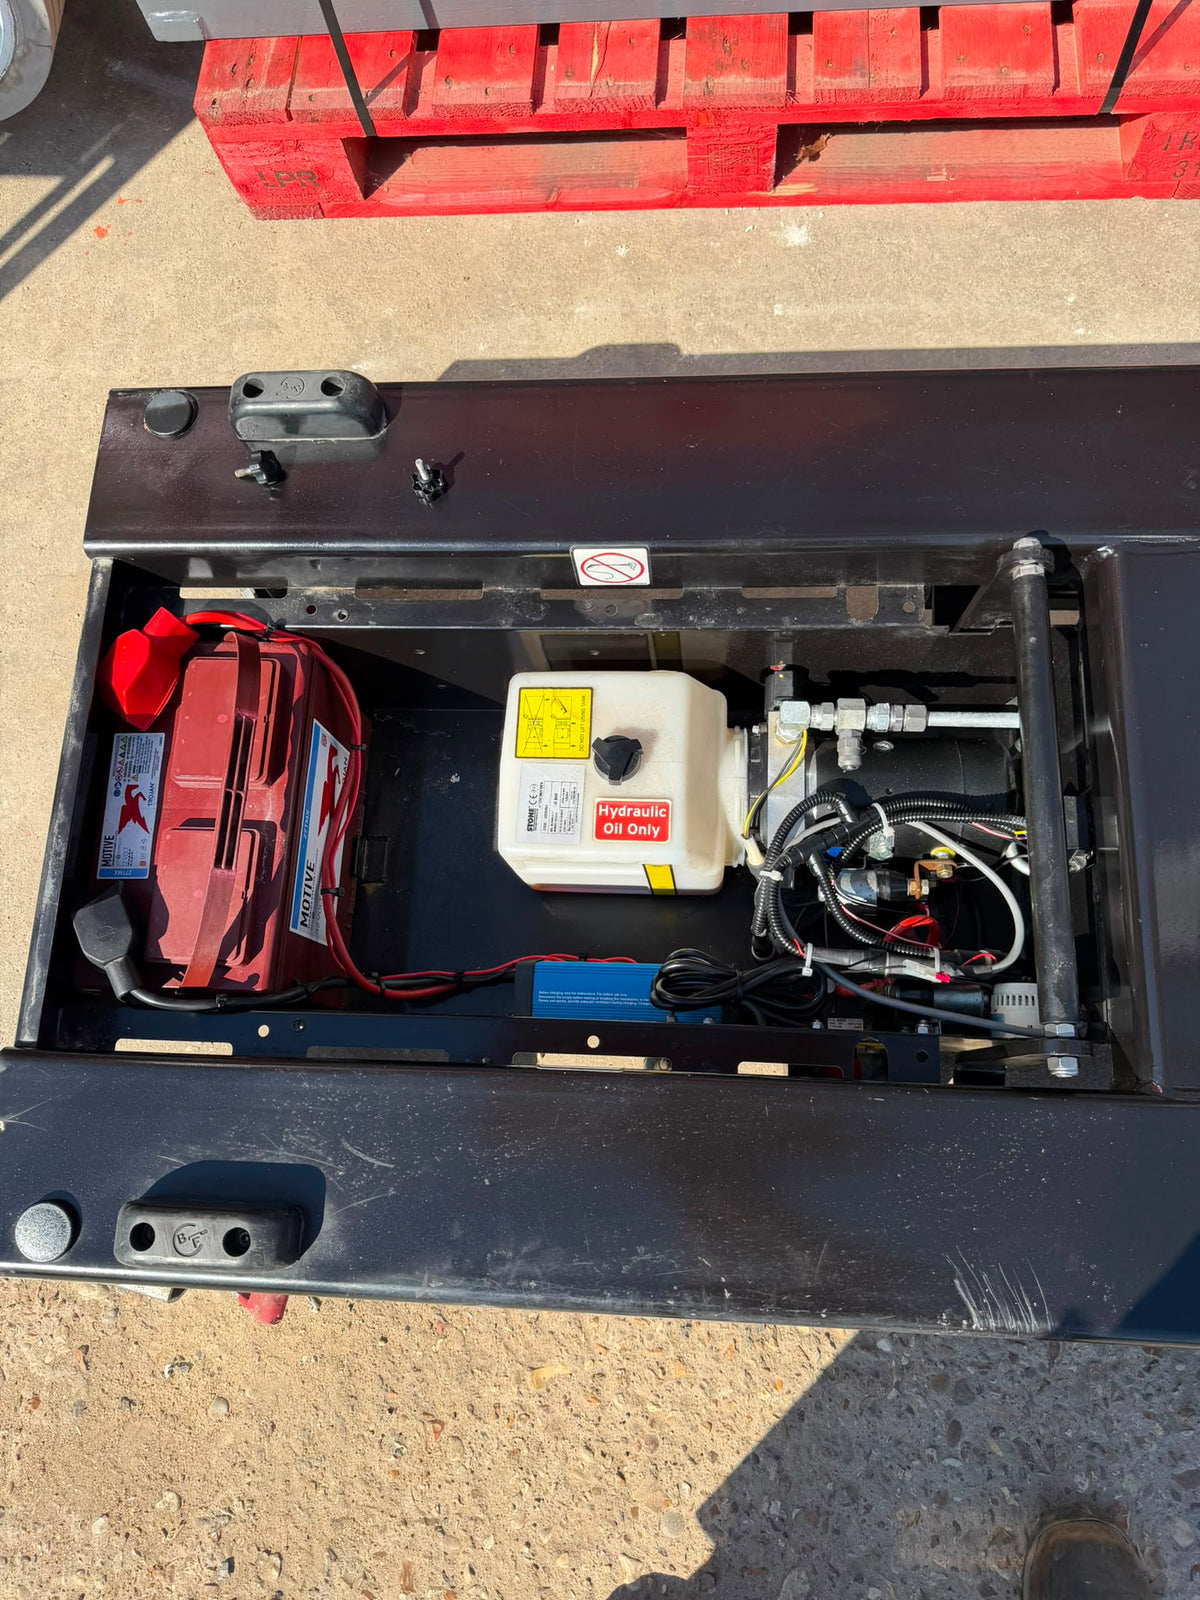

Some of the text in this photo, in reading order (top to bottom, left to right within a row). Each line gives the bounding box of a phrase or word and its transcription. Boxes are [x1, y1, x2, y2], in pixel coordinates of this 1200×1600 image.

[257, 170, 320, 188] LPR
[526, 807, 535, 832] STONE
[598, 804, 667, 819] Hydraulic
[603, 822, 661, 838] Oil Only
[101, 835, 115, 867] MOTIVE
[300, 859, 315, 929] MOTIVE
